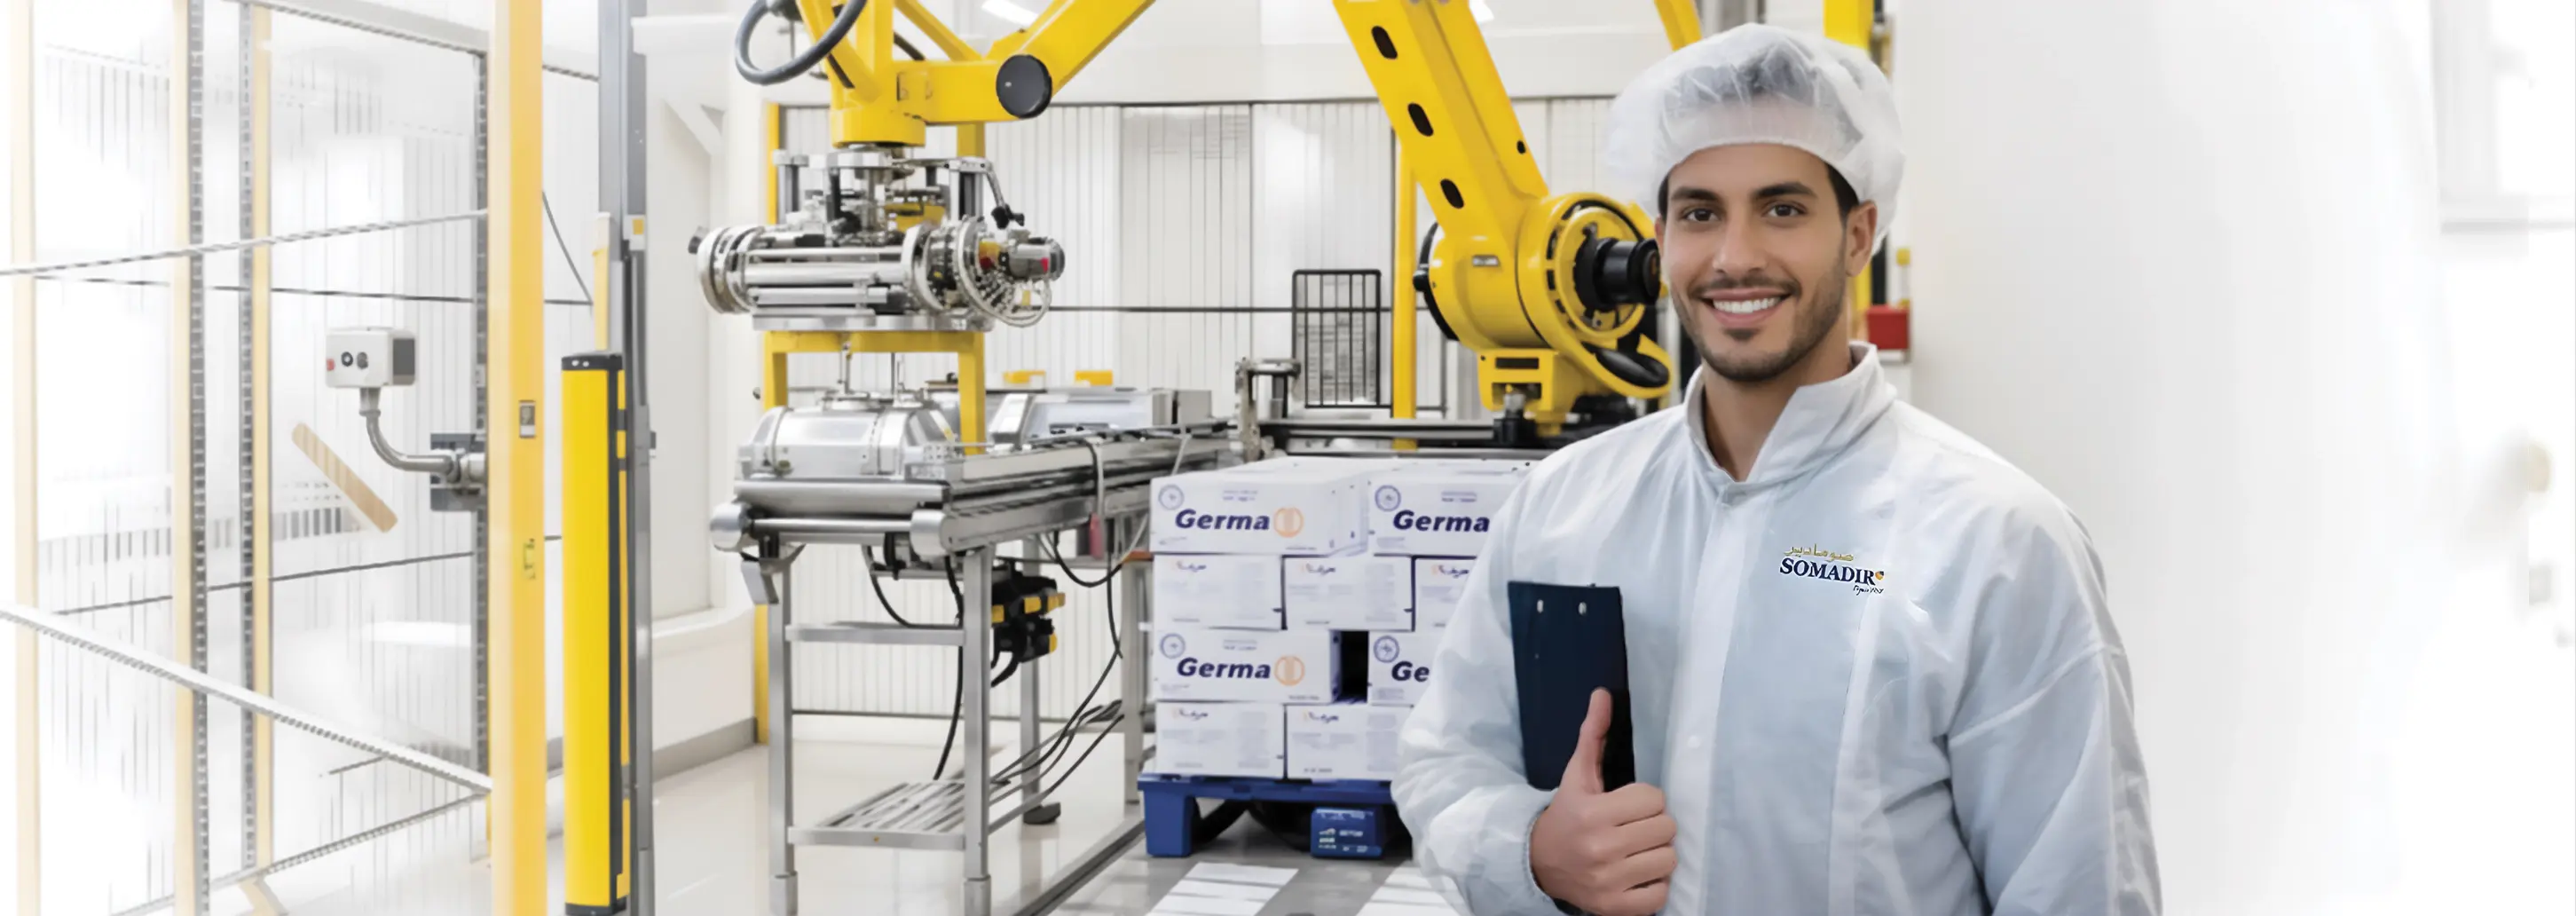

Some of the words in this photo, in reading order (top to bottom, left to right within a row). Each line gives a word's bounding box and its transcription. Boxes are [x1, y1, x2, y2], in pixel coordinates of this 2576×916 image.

[1176, 509, 1270, 530] Germa
[1393, 509, 1490, 532] Germa
[1780, 558, 1875, 585] SOMADIR
[1177, 657, 1270, 678] Germa
